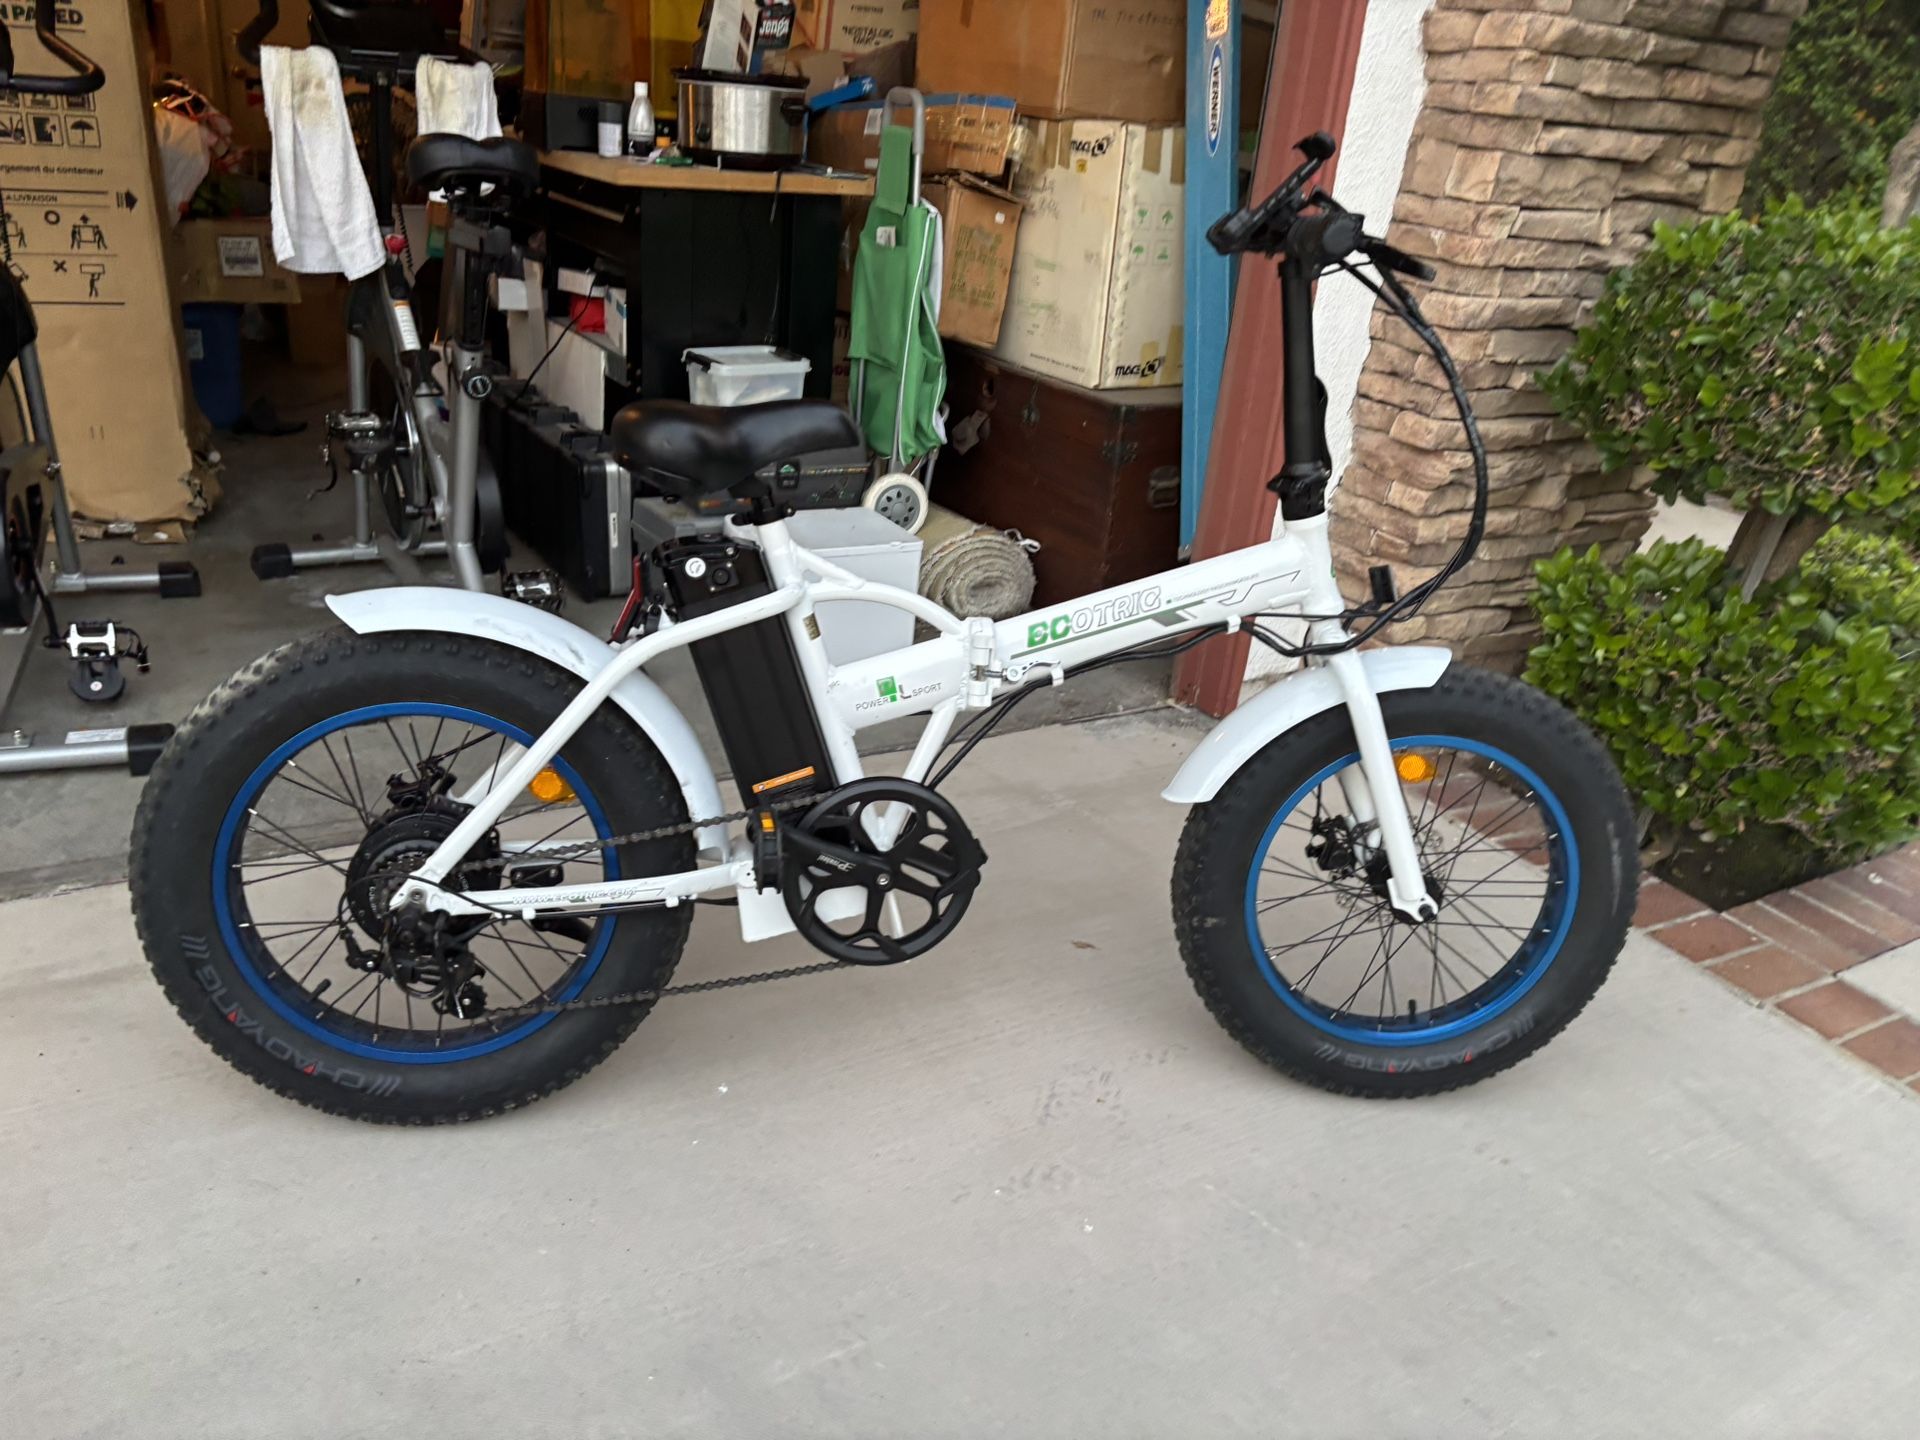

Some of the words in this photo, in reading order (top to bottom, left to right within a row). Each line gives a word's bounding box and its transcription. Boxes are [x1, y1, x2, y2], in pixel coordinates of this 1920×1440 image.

[759, 17, 790, 38] Jenga
[1210, 64, 1221, 133] WERNER
[855, 696, 890, 712] POWER
[912, 682, 942, 697] SPORT
